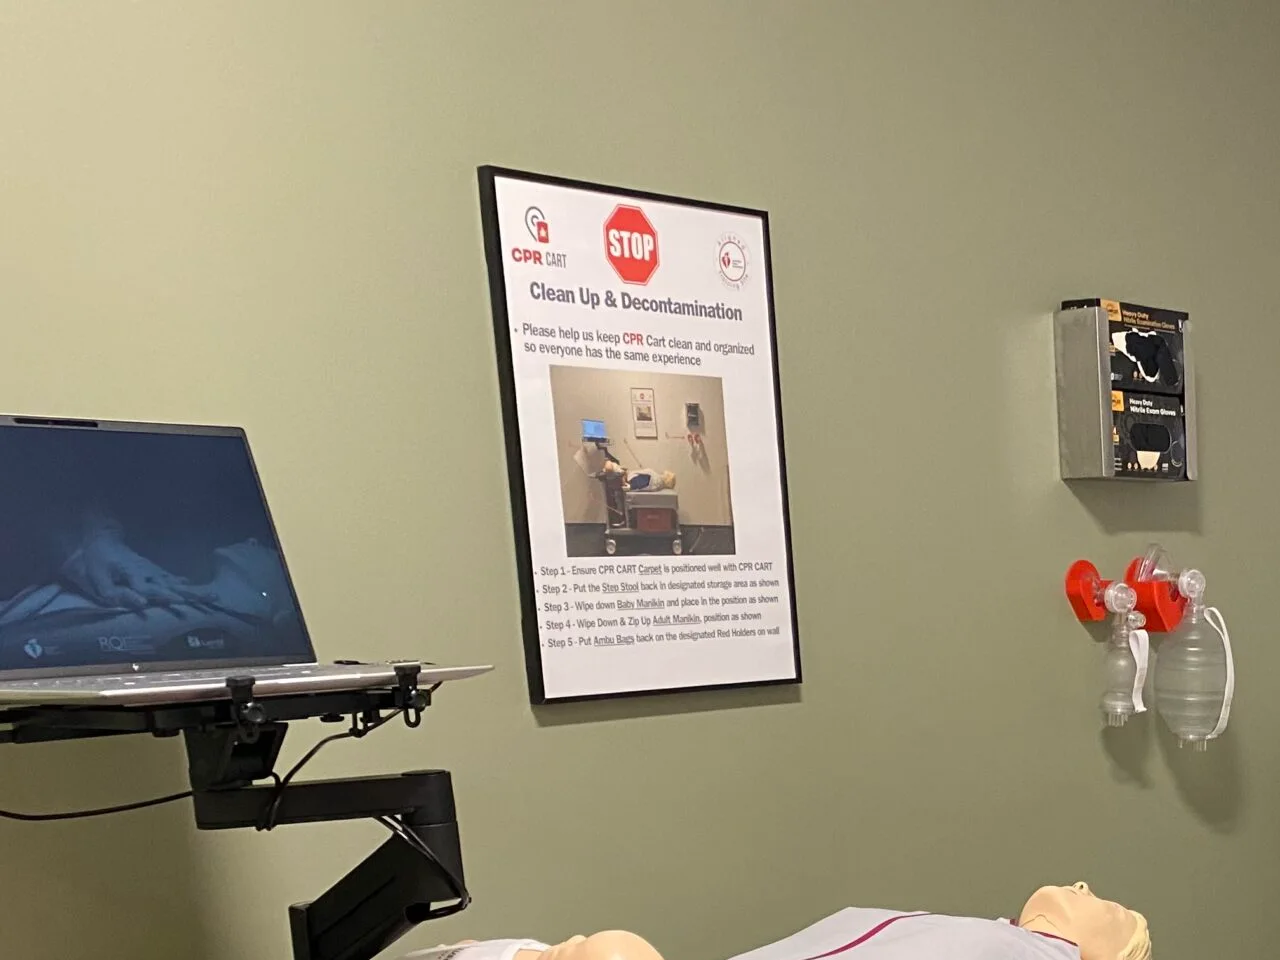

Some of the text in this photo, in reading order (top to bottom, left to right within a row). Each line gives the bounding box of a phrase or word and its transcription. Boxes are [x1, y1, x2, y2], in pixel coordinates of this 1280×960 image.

[608, 229, 653, 260] STOP
[511, 247, 566, 268] CPR CART
[529, 281, 742, 321] Clean Up & Decontamination
[522, 322, 754, 355] Please help us keep CPR Cart clean and organized
[524, 342, 701, 366] so everyone has the same experience
[540, 561, 773, 577] Step 1 Ensure CPR CART Carpet is positioned well with CPR CART
[543, 594, 778, 613] Step 3 Wipe down Baby Manikin and place in the position as shown
